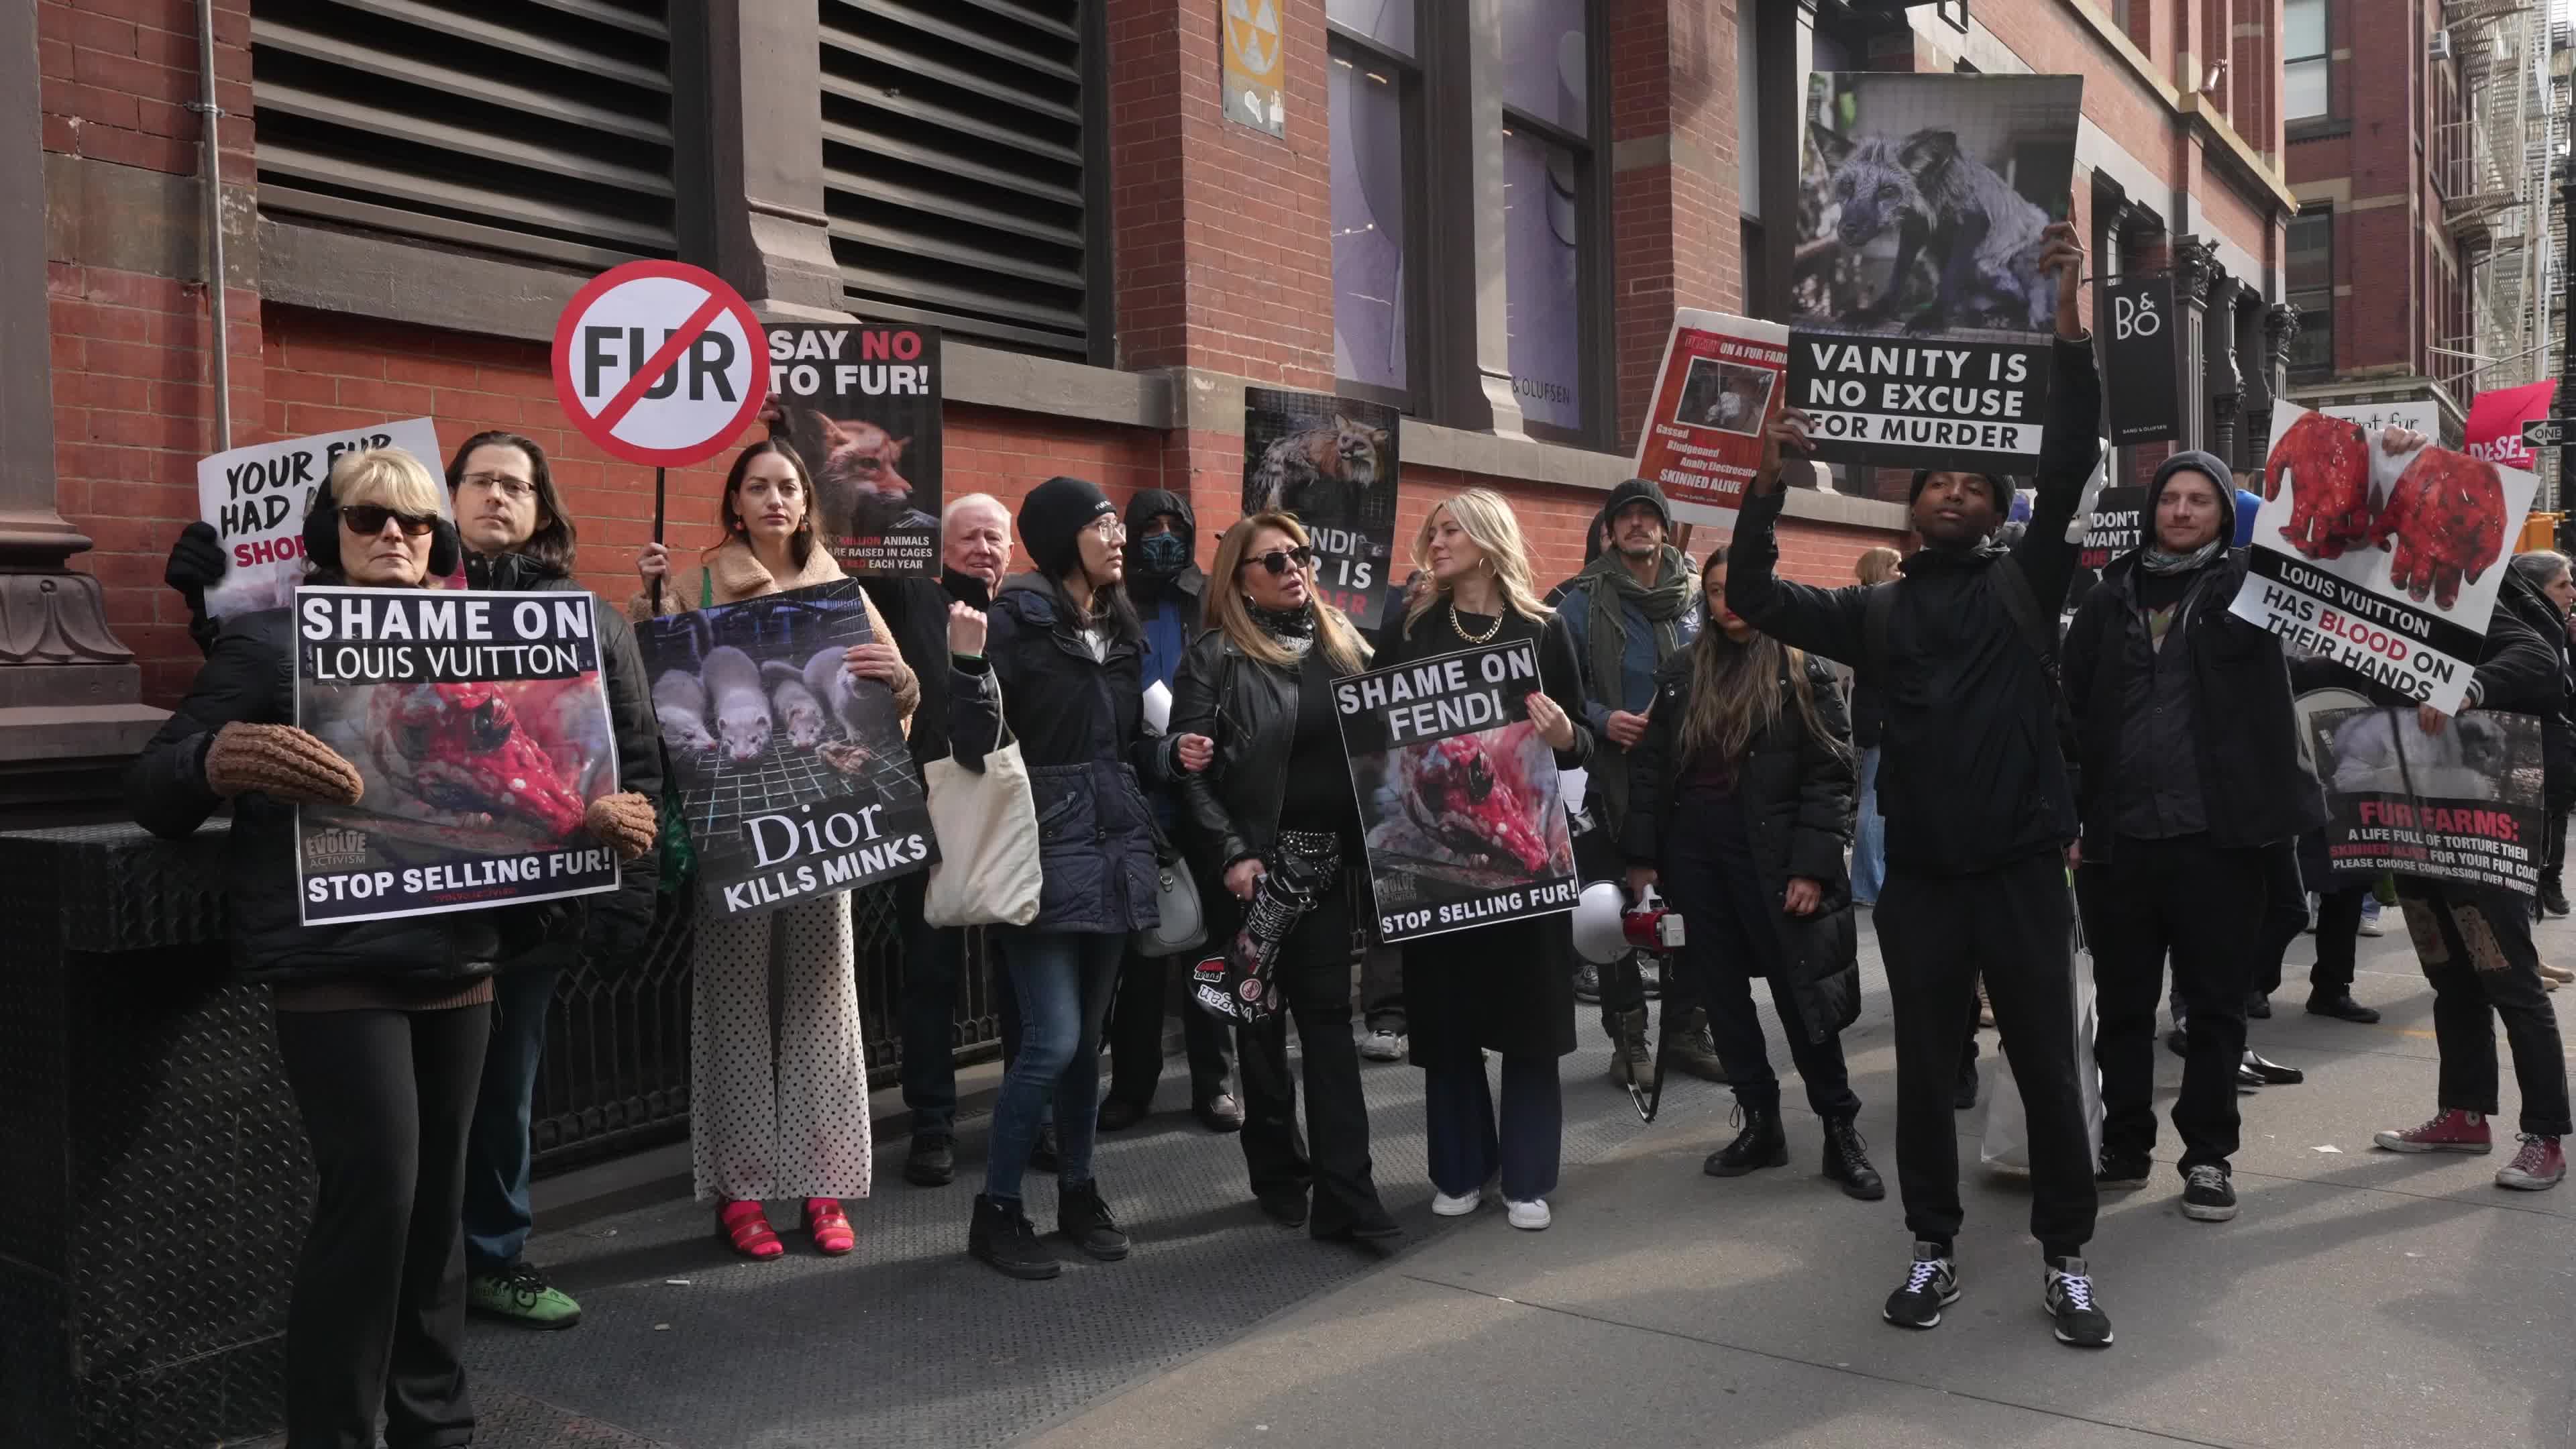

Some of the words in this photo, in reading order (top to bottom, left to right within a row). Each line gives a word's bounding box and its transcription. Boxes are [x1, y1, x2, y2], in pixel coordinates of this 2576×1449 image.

[769, 330, 849, 360] SAY
[862, 331, 922, 360] NO
[1721, 342, 1735, 356] ON
[1735, 345, 1743, 358] A
[1744, 347, 1764, 360] FUR
[584, 326, 737, 402] FUR
[1811, 343, 1971, 379] VANITY
[1989, 353, 2027, 383] IS
[769, 365, 820, 395] TO
[835, 366, 928, 395] FUR!
[1522, 378, 1570, 405] OLUFSEN
[1810, 378, 1866, 407] NO
[1882, 383, 2023, 417] EXCUSE
[1656, 423, 1689, 439] Gassed
[1809, 414, 1868, 438] FOR
[1880, 418, 2019, 449] MURDER
[2535, 429, 2561, 439] ONE
[227, 451, 314, 500] YOUR
[1660, 469, 1709, 489] SKINNED
[1710, 478, 1742, 494] ALIVE
[221, 495, 290, 540] HAD
[2093, 511, 2139, 528] DON'T
[848, 548, 884, 557] RAISED
[887, 549, 898, 557] IN
[900, 548, 932, 557] CAGES
[883, 537, 929, 546] ANIMALS
[2083, 531, 2129, 547] WANT
[869, 559, 895, 569] EACH
[898, 560, 923, 569] YEAR
[1338, 560, 1372, 589] IS
[2082, 550, 2106, 566] DIE
[2280, 561, 2335, 598] LOUIS
[2340, 586, 2430, 638] VUITTON
[303, 598, 489, 641] SHAME
[513, 600, 589, 640] ON
[2263, 585, 2315, 621] HAS
[2318, 610, 2407, 661] BLOOD
[2413, 651, 2454, 684] ON
[316, 646, 414, 679] LOUIS
[426, 643, 580, 677] VUITTON
[2267, 612, 2337, 658] THEIR
[2341, 645, 2434, 702] HANDS
[1338, 660, 1467, 714] SHAME
[1481, 648, 1534, 683] ON
[1389, 689, 1503, 741] FENDI
[743, 804, 881, 868] Dior
[2359, 801, 2412, 827] FUR
[2420, 807, 2520, 842] FARMS:
[306, 828, 365, 856] EVOLVE
[2349, 828, 2359, 841] A
[2361, 828, 2390, 841] LIFE
[2393, 829, 2424, 844] FULL
[2426, 835, 2442, 847] OF
[2444, 836, 2500, 854] TORTURE
[2500, 843, 2528, 861] THEN
[308, 871, 394, 902] STOP
[403, 857, 540, 893] SELLING
[549, 847, 610, 877] FUR!
[311, 855, 365, 869] ACTIVISM
[724, 866, 817, 912] KILLS
[822, 835, 927, 885] MINKS
[2333, 859, 2373, 869] PLEASE
[2376, 859, 2415, 871] CHOOSE
[2418, 863, 2481, 880] COMPASSION
[2483, 872, 2503, 885] OVER
[2430, 850, 2455, 864] FOR
[2458, 853, 2490, 869] YOUR
[2493, 859, 2513, 875] FUR
[1382, 910, 1431, 933] STOP
[1440, 893, 1521, 923] SELLING
[1530, 879, 1577, 906] FUR!
